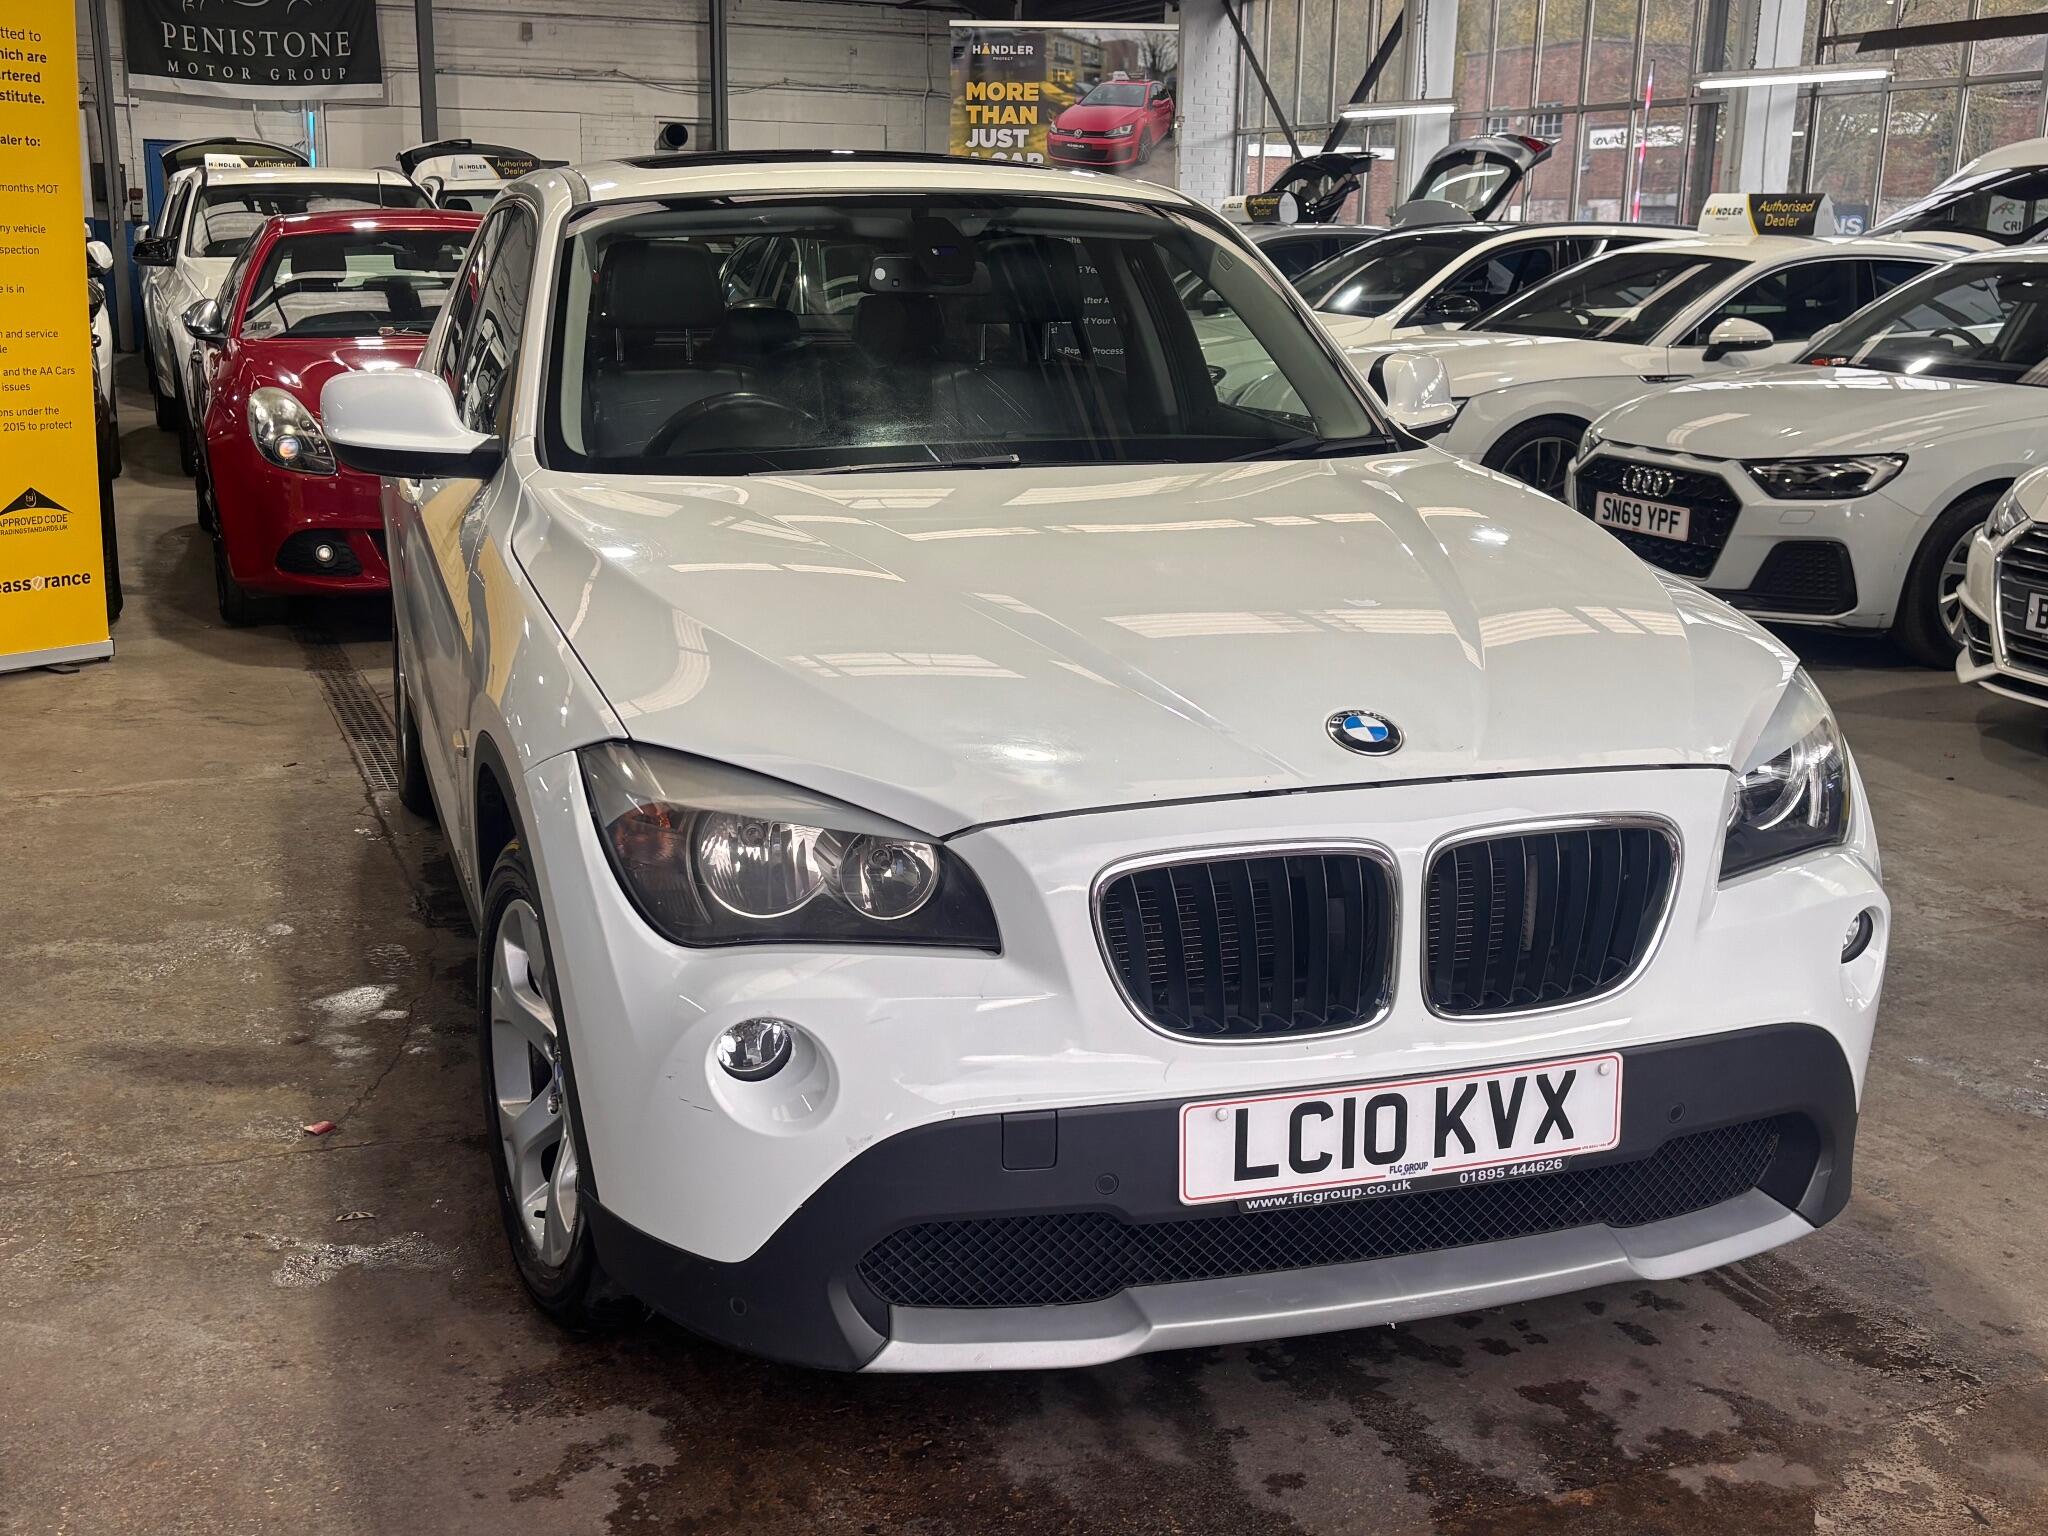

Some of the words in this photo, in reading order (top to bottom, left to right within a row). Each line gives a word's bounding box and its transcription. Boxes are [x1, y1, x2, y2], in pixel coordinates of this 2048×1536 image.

[29, 30, 41, 42] to
[161, 21, 351, 58] PENISTONE
[27, 52, 47, 63] are
[0, 69, 41, 83] rtered
[168, 60, 251, 79] MOTOR
[270, 67, 346, 81] GROUP
[966, 82, 1040, 101] MORE
[966, 105, 1038, 125] THAN
[25, 135, 41, 147] to:
[965, 128, 1030, 148] JUST
[36, 184, 59, 194] MOT
[1758, 199, 1815, 213] Authorised
[1764, 213, 1800, 227] Dealer
[13, 224, 46, 234] vehicle
[6, 284, 14, 294] is
[16, 284, 25, 294] in
[5, 329, 23, 339] and
[25, 329, 59, 338] service
[1092, 347, 1125, 355] Process
[3, 367, 20, 377] and
[23, 367, 37, 376] the
[40, 366, 53, 376] AA
[55, 366, 76, 375] Cars
[2, 383, 31, 392] issues
[16, 407, 42, 417] under
[45, 406, 60, 415] the
[3, 422, 26, 432] 2015
[28, 421, 38, 430] to
[40, 420, 73, 432] protect
[44, 513, 68, 524] CODE
[1602, 497, 1642, 527] SN69
[1647, 505, 1682, 534] YPF
[1233, 1092, 1409, 1182] LC10
[1433, 1069, 1578, 1159] KVX
[1389, 1163, 1403, 1175] FLC
[1404, 1161, 1429, 1172] GROUP
[1245, 1179, 1412, 1209] www.flcgroup.co.uk
[1459, 1167, 1505, 1184] 01895
[1509, 1158, 1563, 1176] 444626
